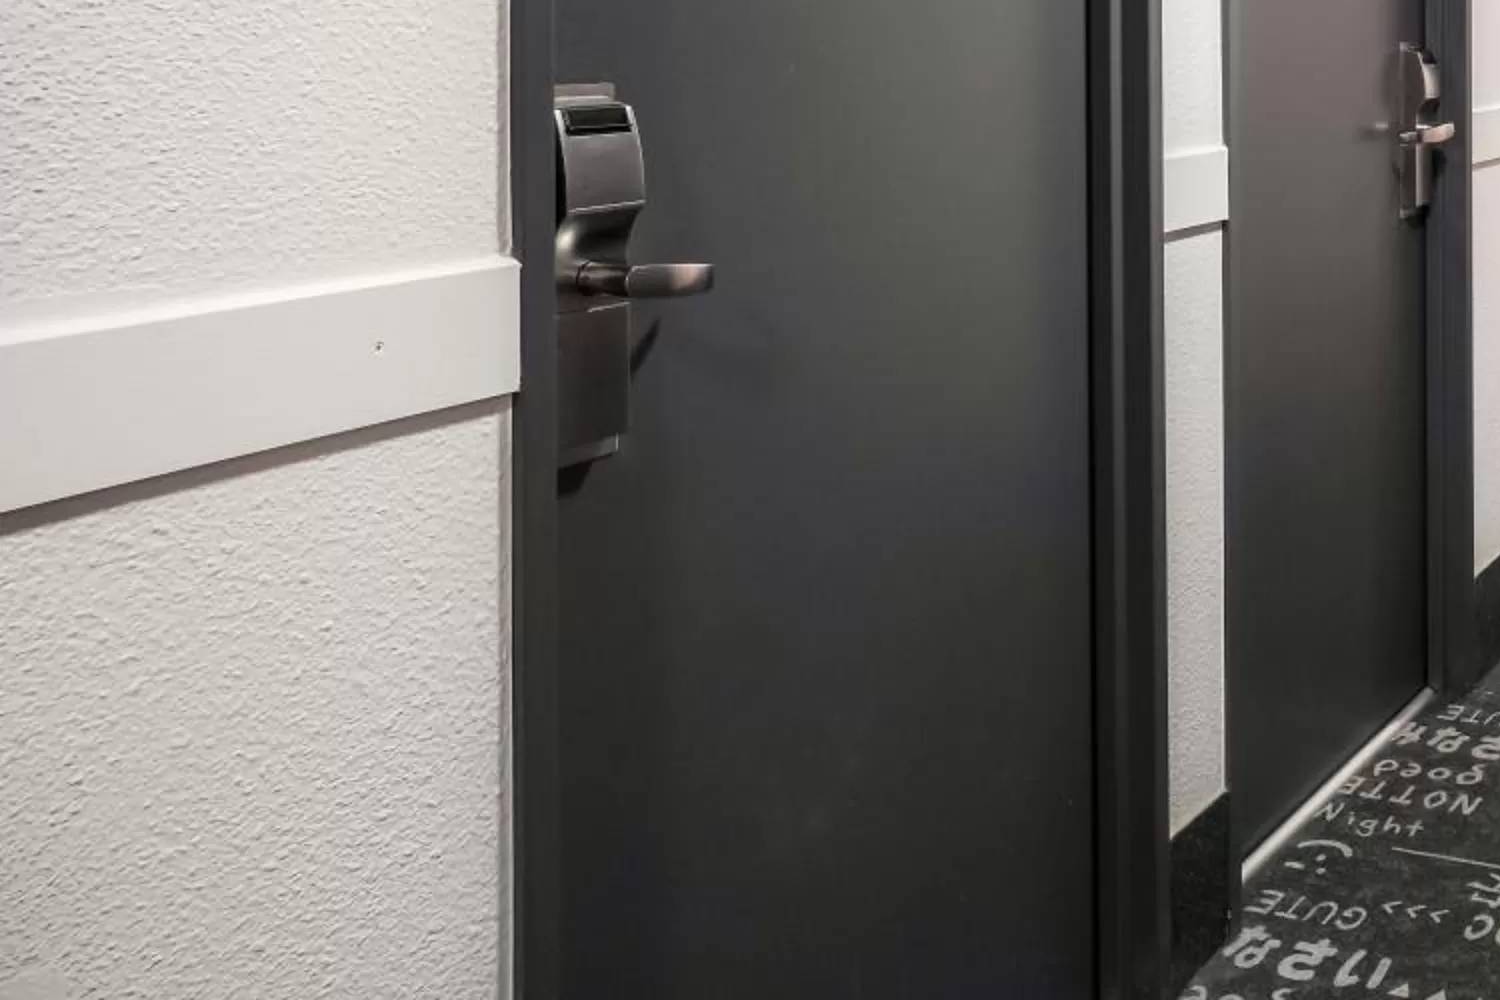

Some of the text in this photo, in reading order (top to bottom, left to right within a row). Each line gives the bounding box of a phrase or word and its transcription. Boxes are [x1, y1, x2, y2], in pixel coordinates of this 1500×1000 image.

[1336, 775, 1484, 816] NOTTE
[1312, 801, 1425, 837] Night
[1243, 888, 1368, 931] GUTE
